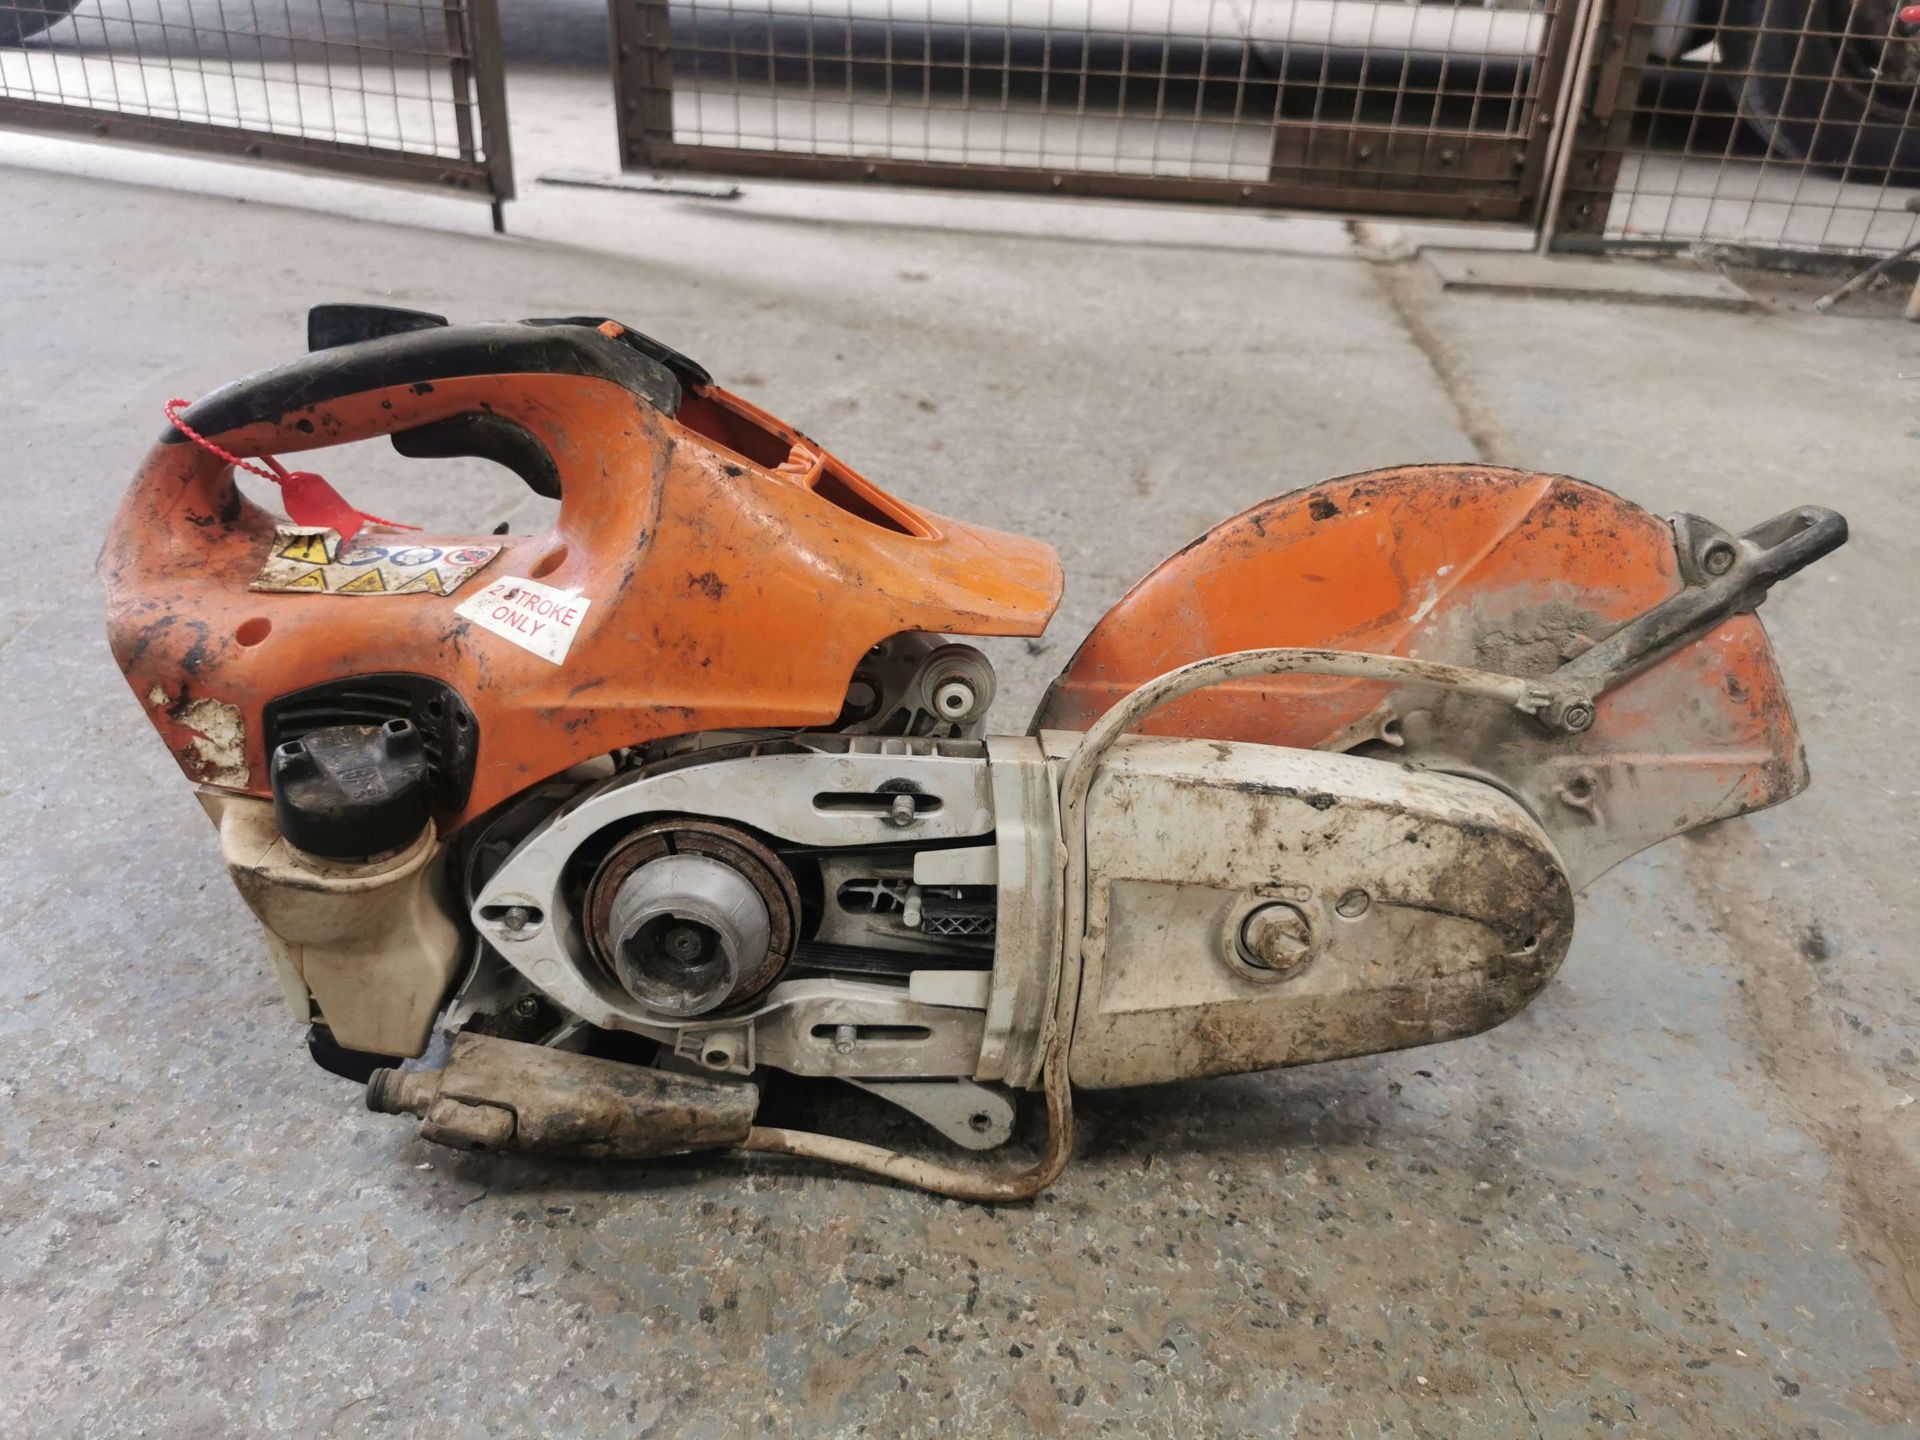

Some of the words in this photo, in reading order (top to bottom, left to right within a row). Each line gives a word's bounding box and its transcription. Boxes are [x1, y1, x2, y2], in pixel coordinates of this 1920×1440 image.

[488, 584, 505, 596] 2
[503, 587, 577, 627] STROKE
[491, 606, 546, 637] ONLY
